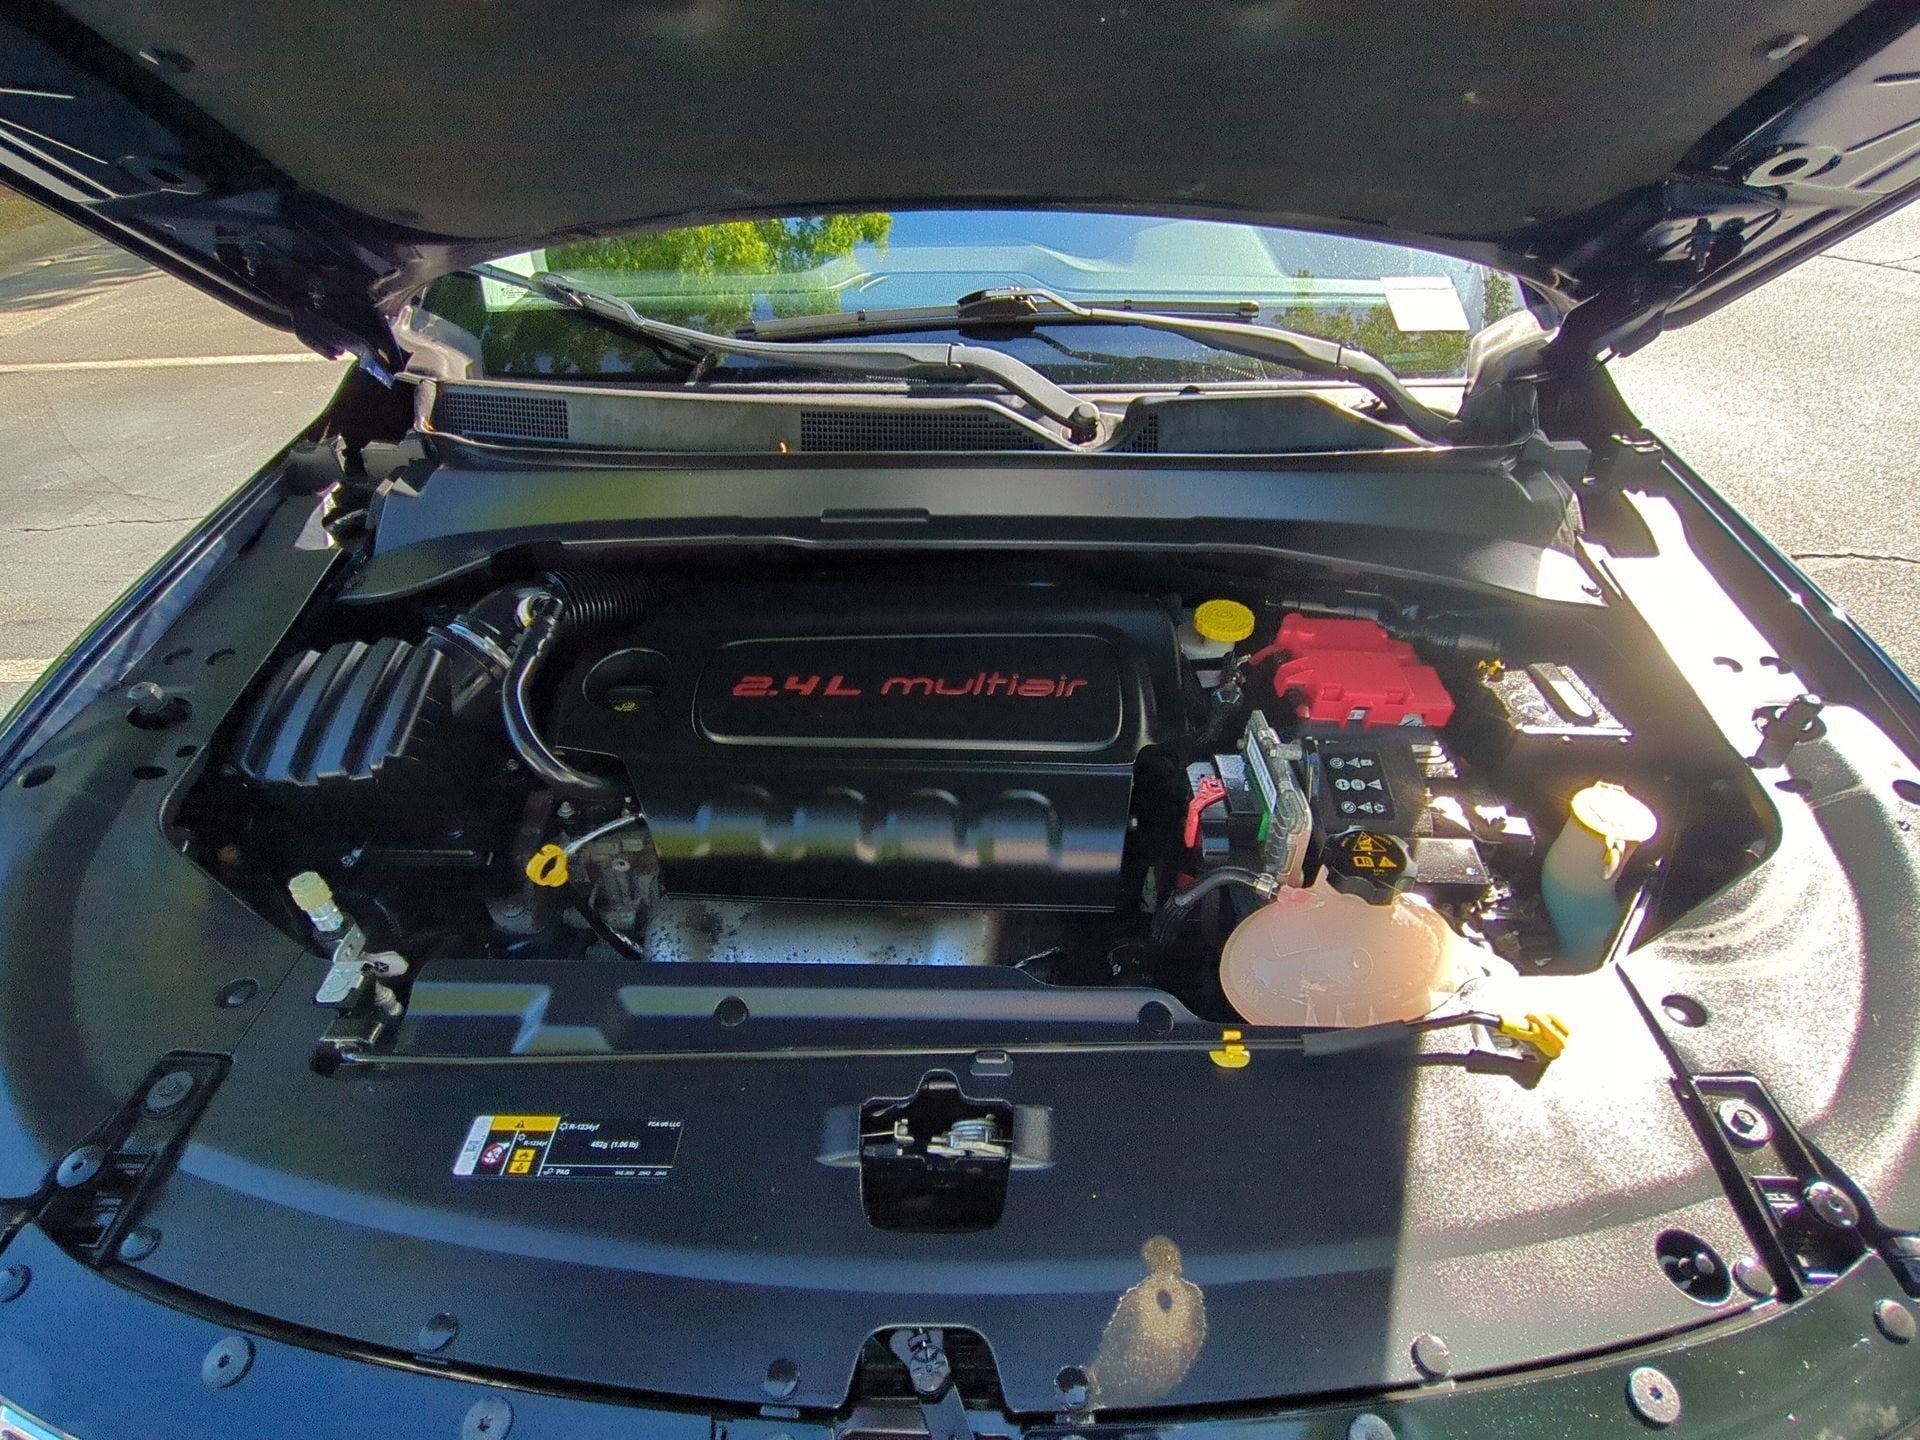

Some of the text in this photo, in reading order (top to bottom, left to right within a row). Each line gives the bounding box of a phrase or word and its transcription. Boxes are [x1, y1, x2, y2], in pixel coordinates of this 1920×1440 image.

[732, 671, 1089, 698] 2.4L multiair
[555, 1168, 571, 1176] PAG
